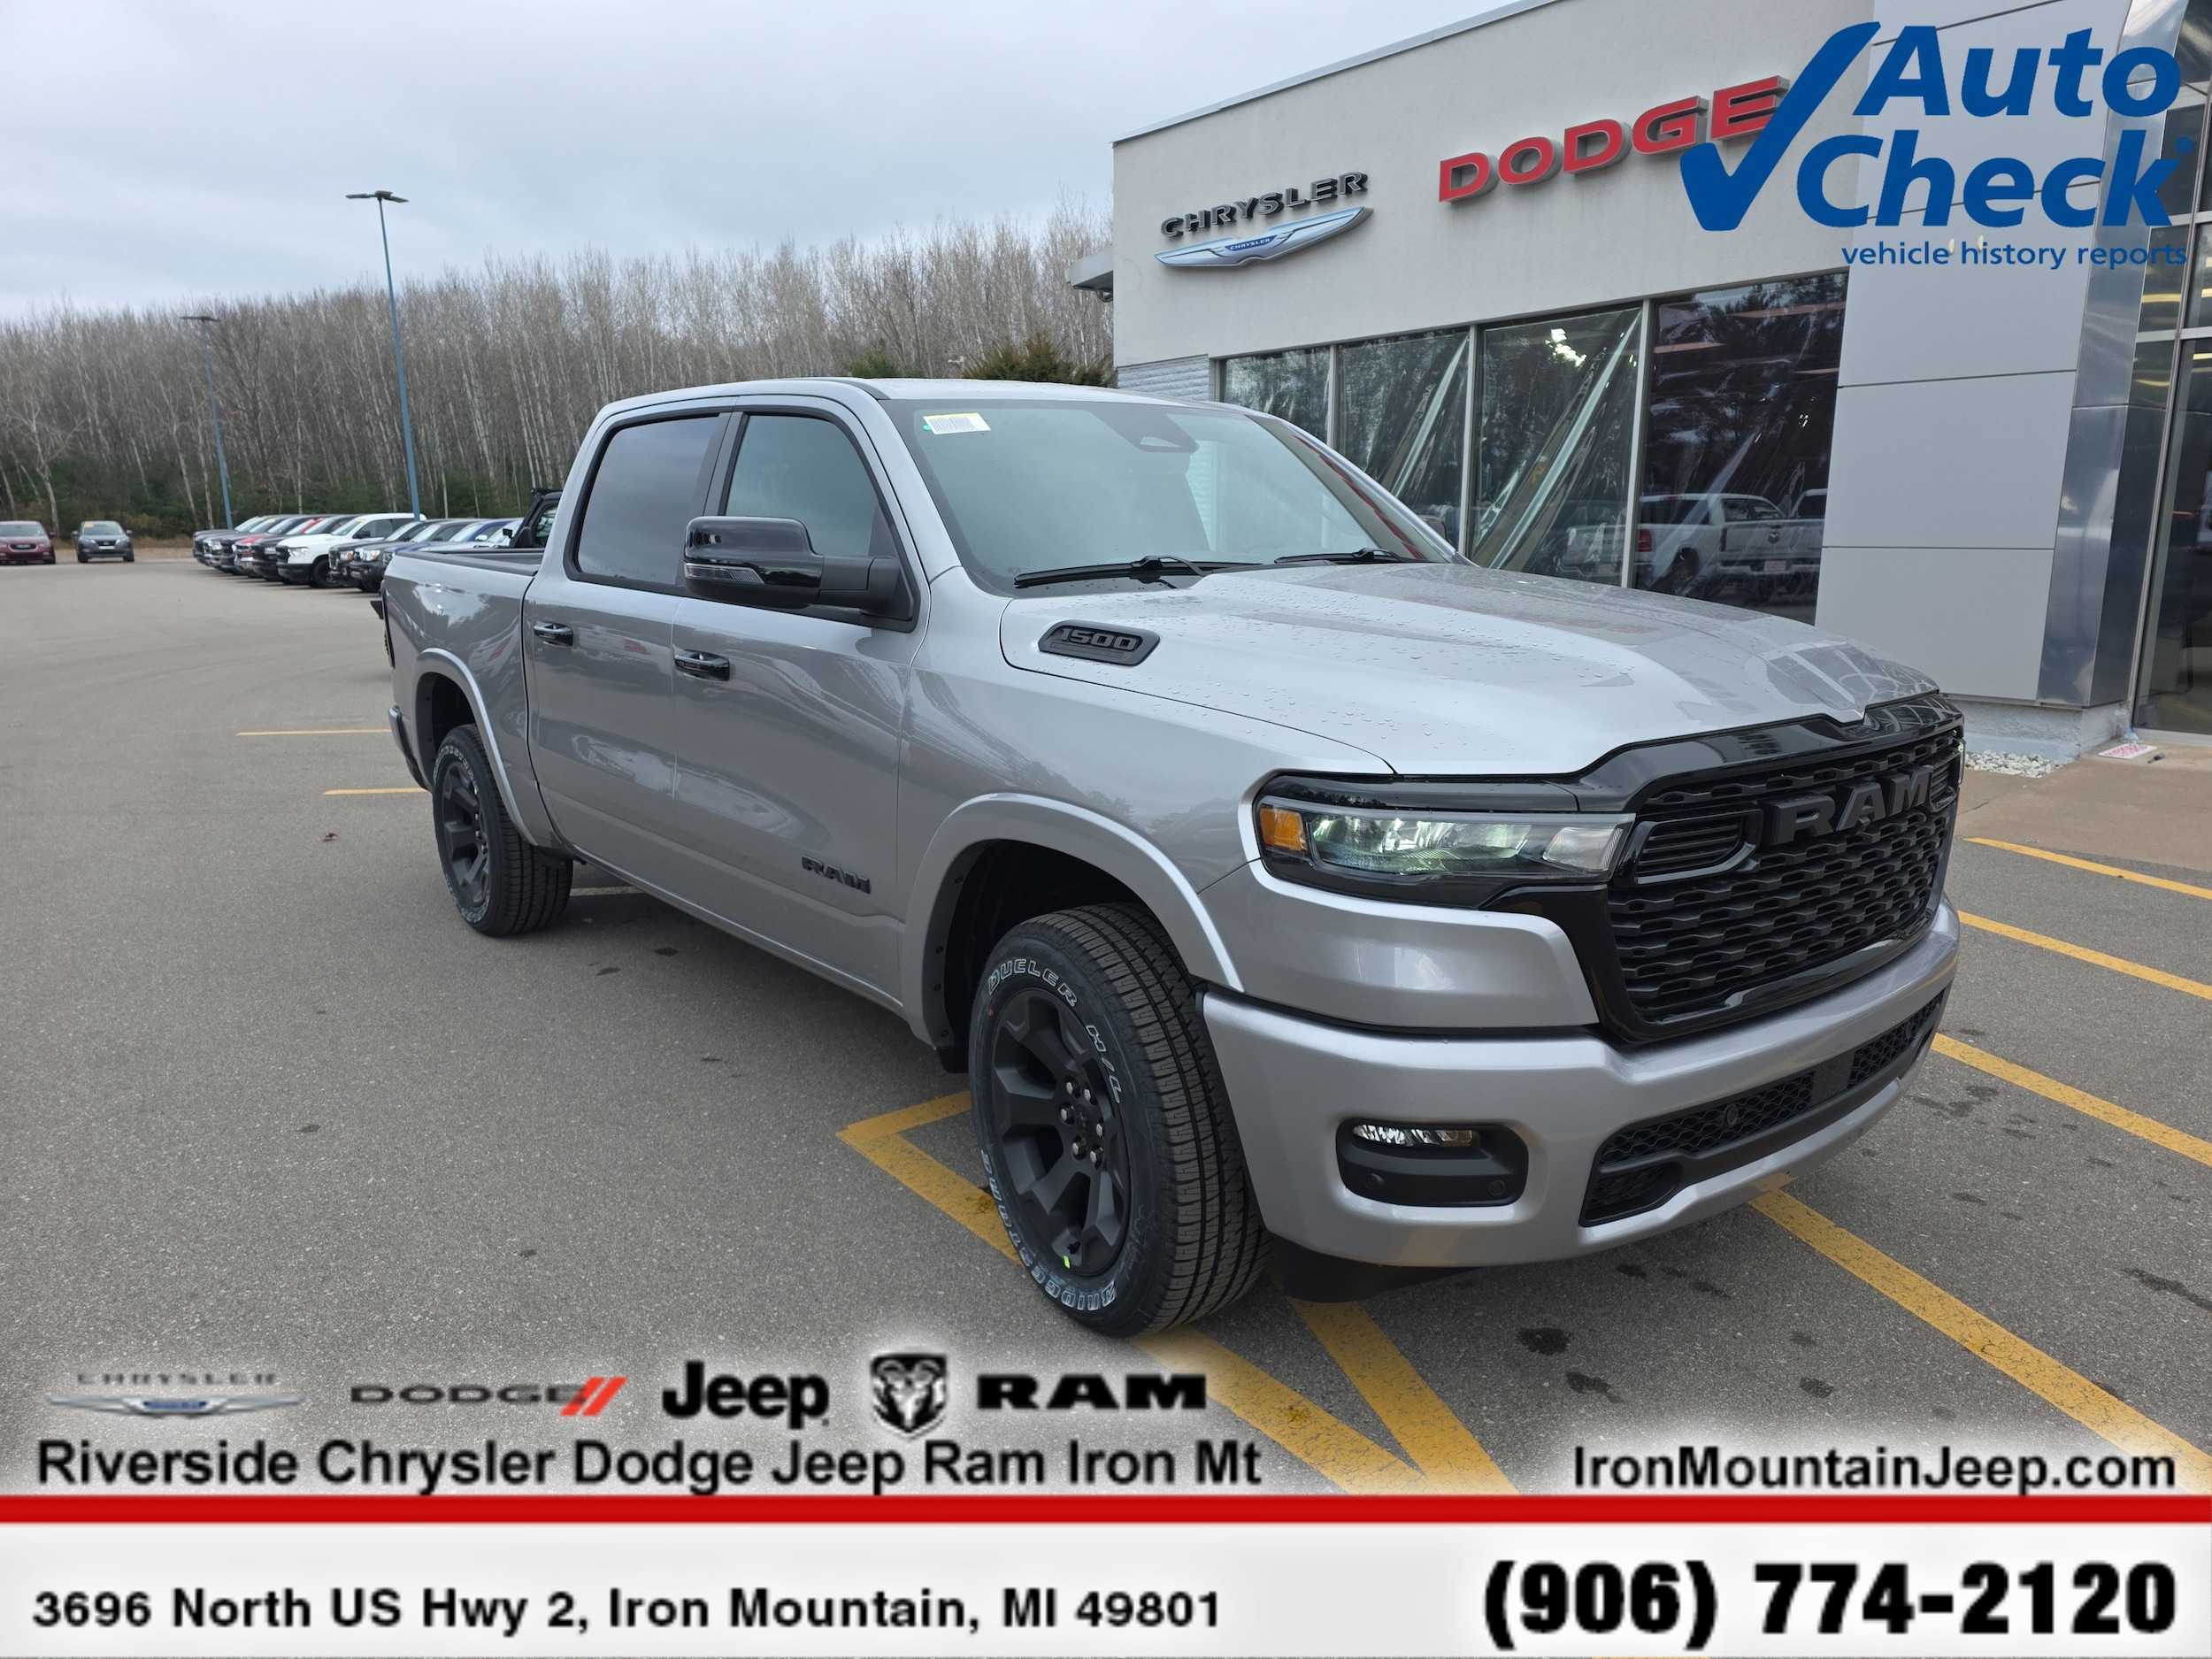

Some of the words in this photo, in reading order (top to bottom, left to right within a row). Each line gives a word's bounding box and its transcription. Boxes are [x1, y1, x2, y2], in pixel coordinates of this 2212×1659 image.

[1439, 75, 1791, 204] DODGE
[1160, 171, 1369, 238] CHRYSLER
[1229, 237, 1271, 251] CHRYSLER
[1061, 627, 1139, 651] 1500
[1770, 764, 1935, 846] RAM
[802, 855, 872, 895] RAM
[987, 958, 1078, 1008] DUELER
[1086, 1025, 1122, 1104] H/L
[980, 1148, 1118, 1311] BRIDGESTONE
